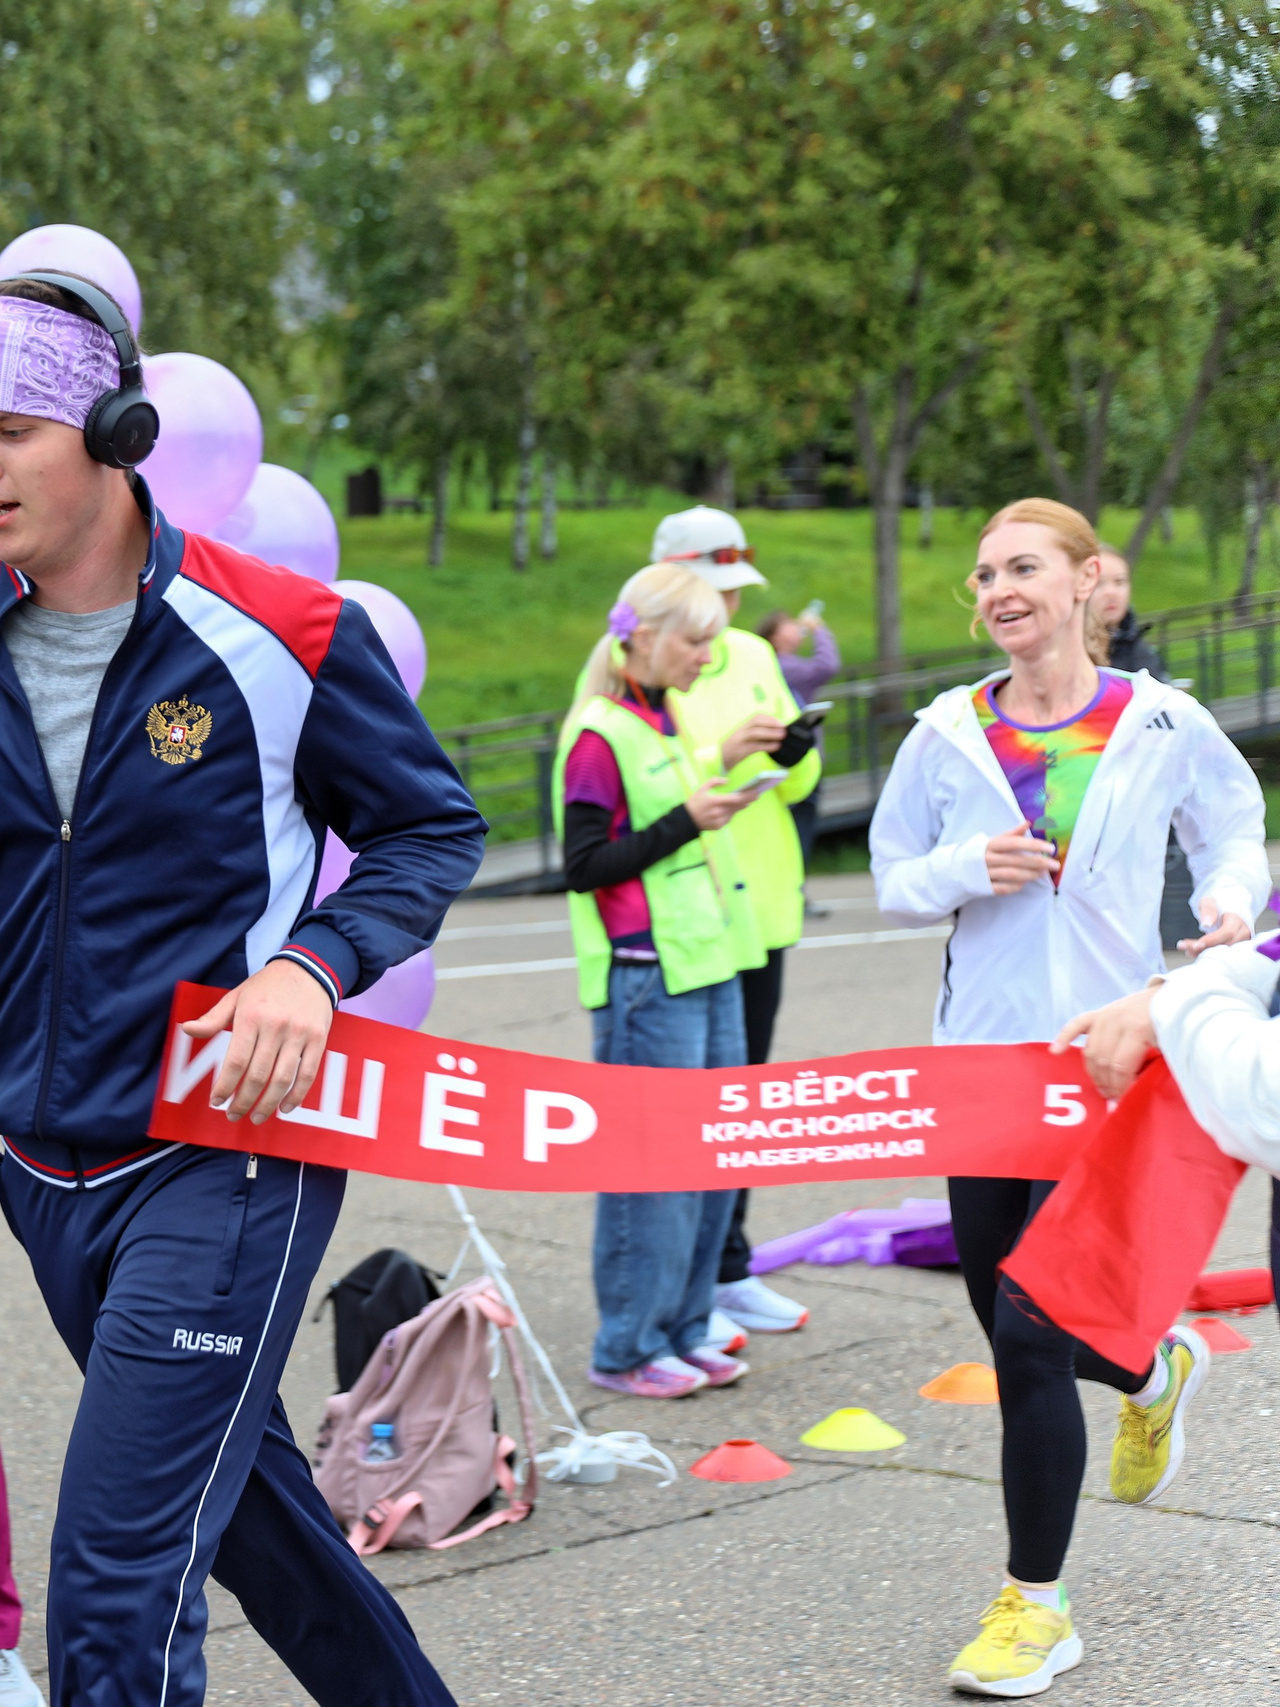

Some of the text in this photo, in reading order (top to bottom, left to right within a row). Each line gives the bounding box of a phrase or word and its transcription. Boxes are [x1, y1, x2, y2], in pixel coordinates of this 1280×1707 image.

[718, 1068, 918, 1113] 5 ВЁРСТ
[1042, 1084, 1087, 1126] 5
[701, 1107, 938, 1143] КРАСНОЯРСК
[717, 1139, 924, 1168] НАБЕРЕЖНАЯ
[172, 1328, 243, 1355] RUSSIA
